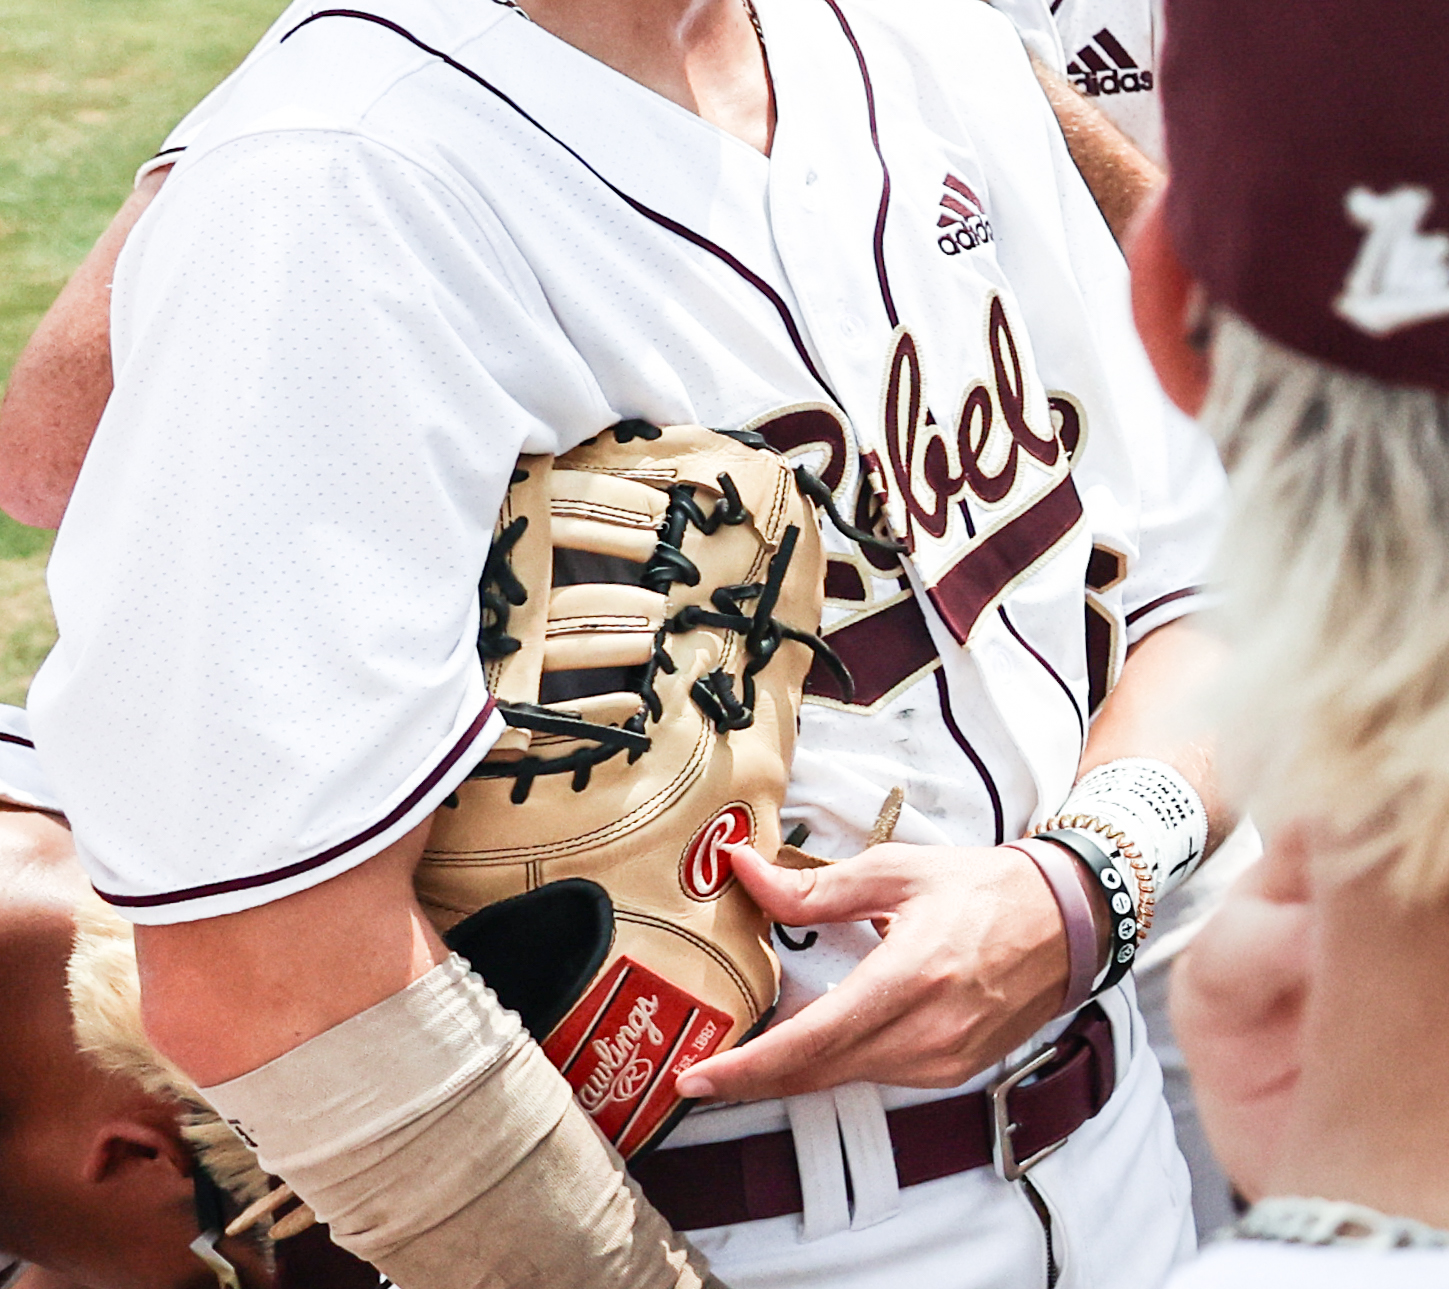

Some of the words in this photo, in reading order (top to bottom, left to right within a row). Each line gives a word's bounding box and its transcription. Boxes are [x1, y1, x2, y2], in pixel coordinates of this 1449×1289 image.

[1073, 68, 1154, 97] didas
[937, 210, 995, 256] adid
[577, 993, 665, 1116] awlings
